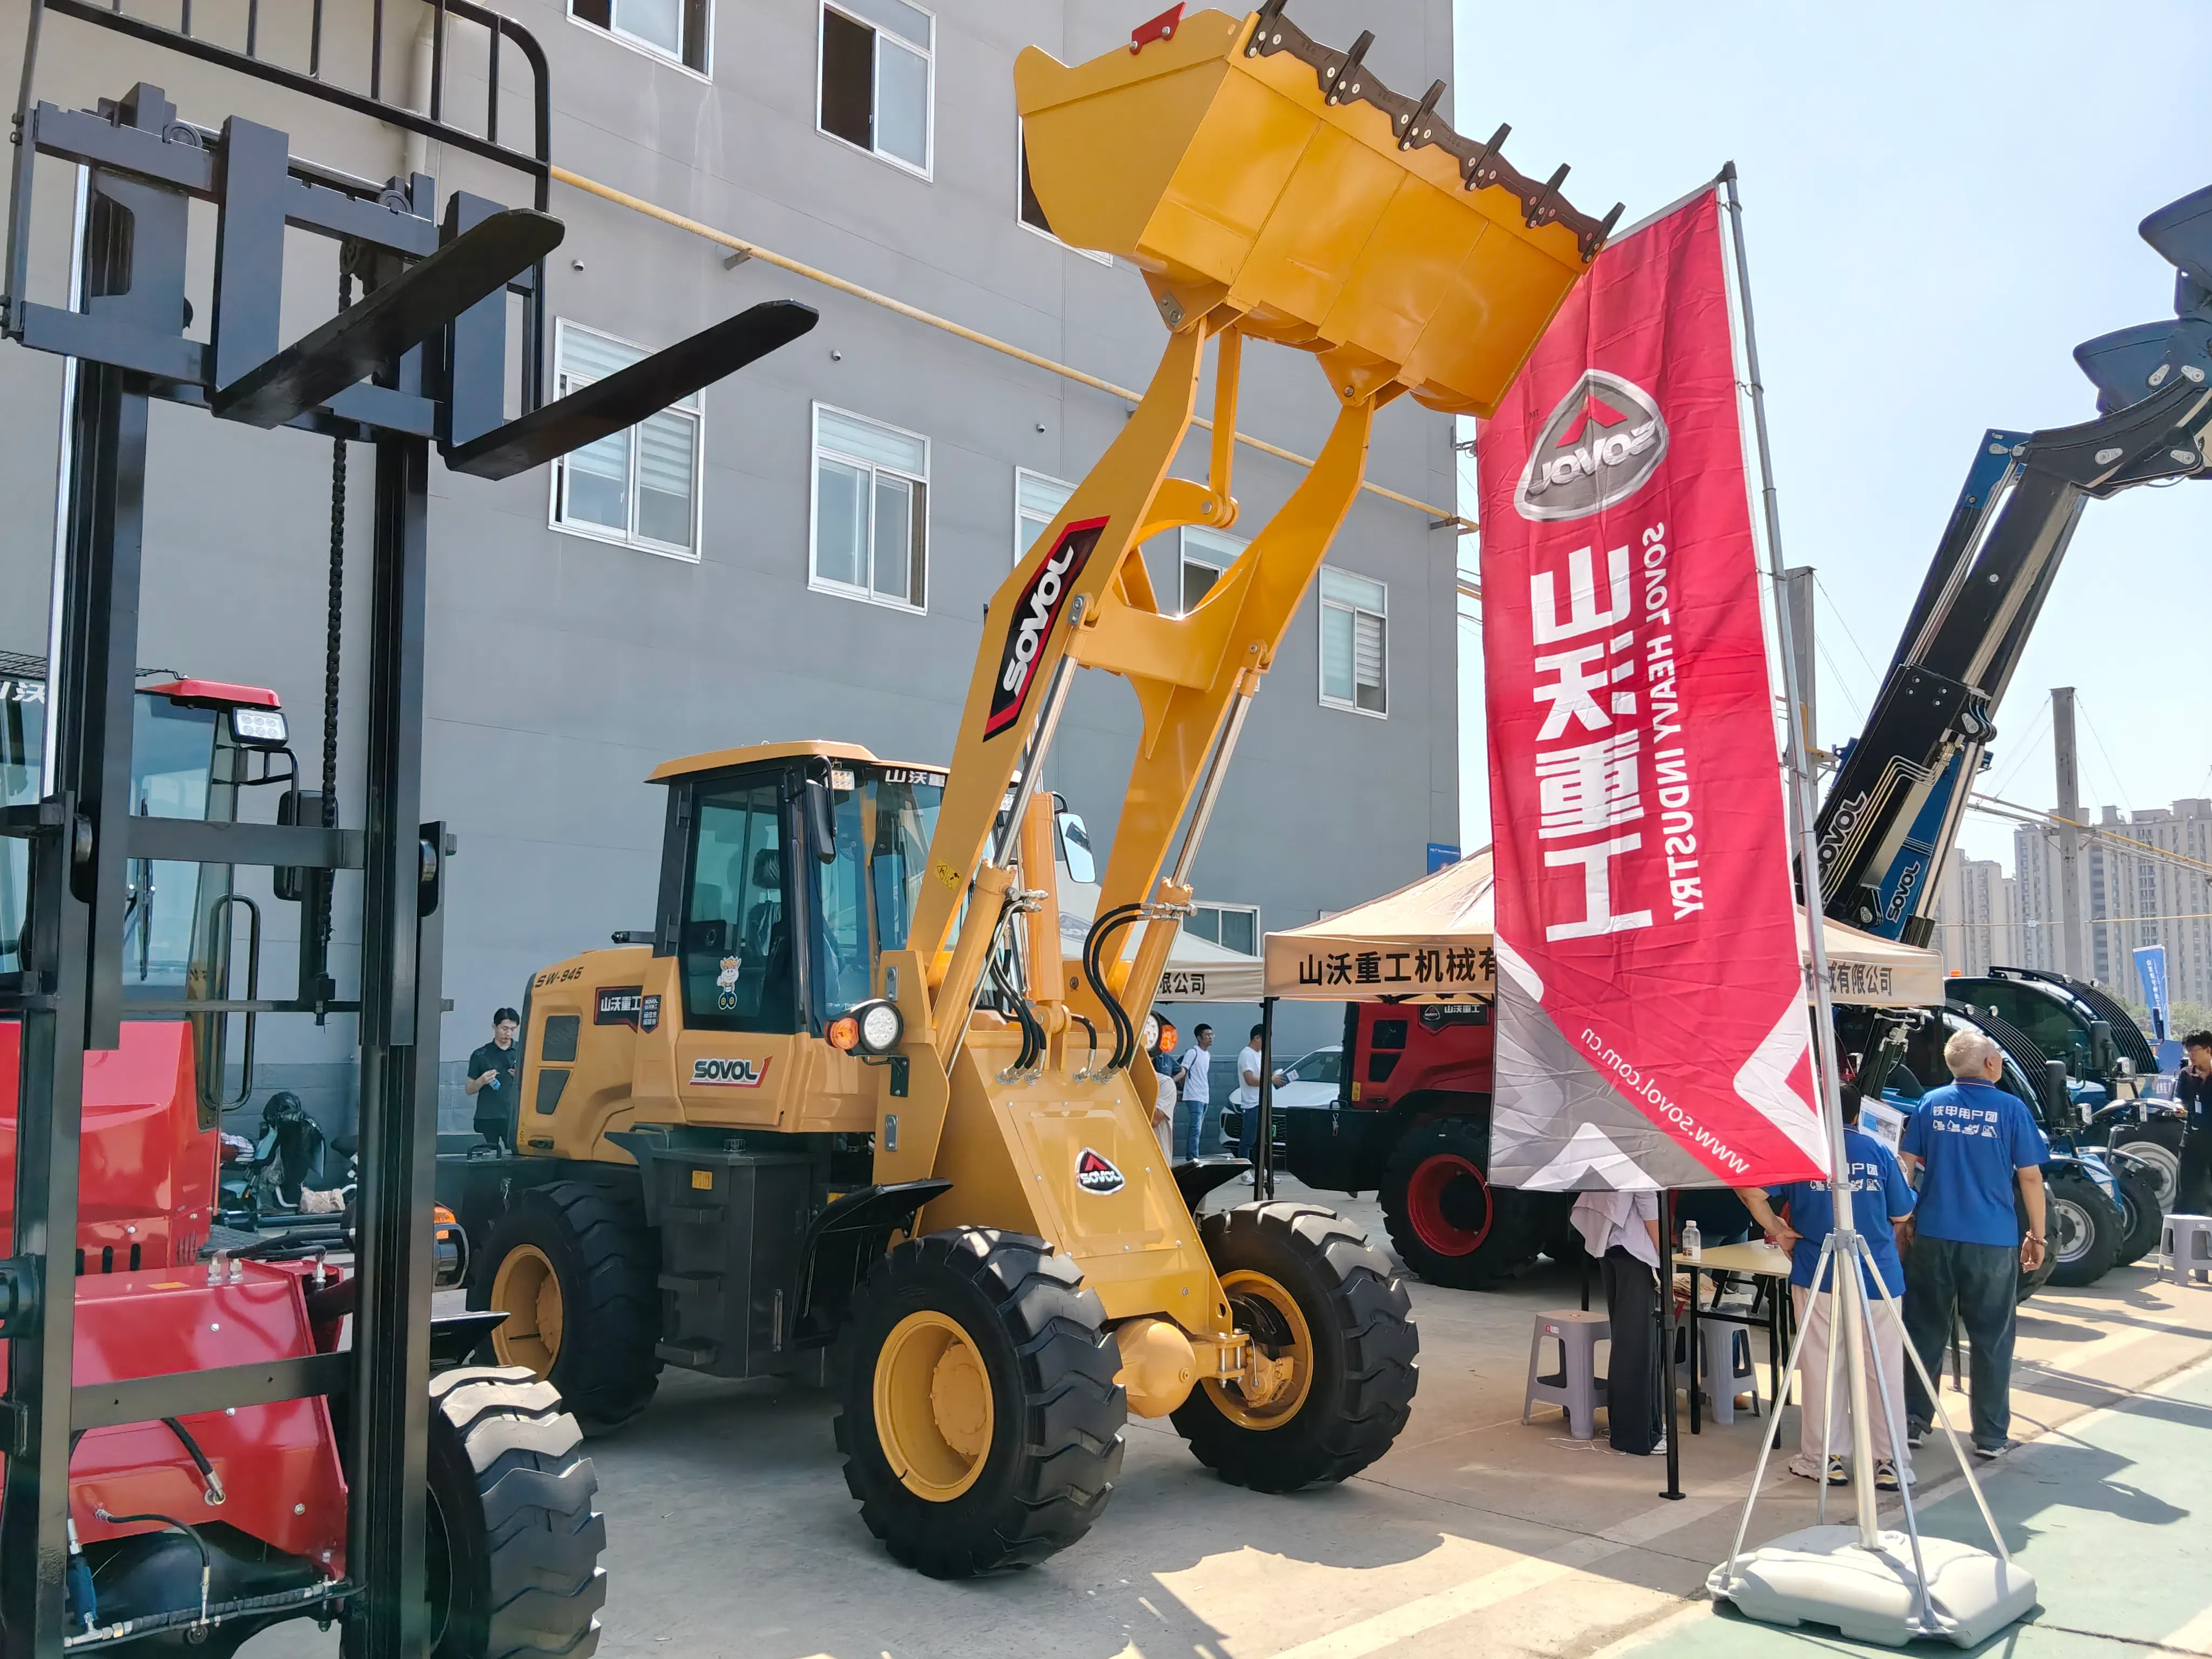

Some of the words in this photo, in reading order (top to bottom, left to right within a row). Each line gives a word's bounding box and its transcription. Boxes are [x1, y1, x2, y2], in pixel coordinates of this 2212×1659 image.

[1003, 545, 1074, 697] SOVOL
[0, 681, 45, 704] 沃
[1886, 861, 1920, 923] SOVOL
[534, 966, 584, 988] SW-945
[600, 995, 642, 1011] 山沃重工
[1444, 1004, 1480, 1014] 山沃重工
[693, 1059, 758, 1081] SOVOL
[1932, 1105, 1998, 1123] 铁甲用户团
[1080, 1170, 1122, 1185] SOVOL
[1846, 1162, 1879, 1176] 户团
